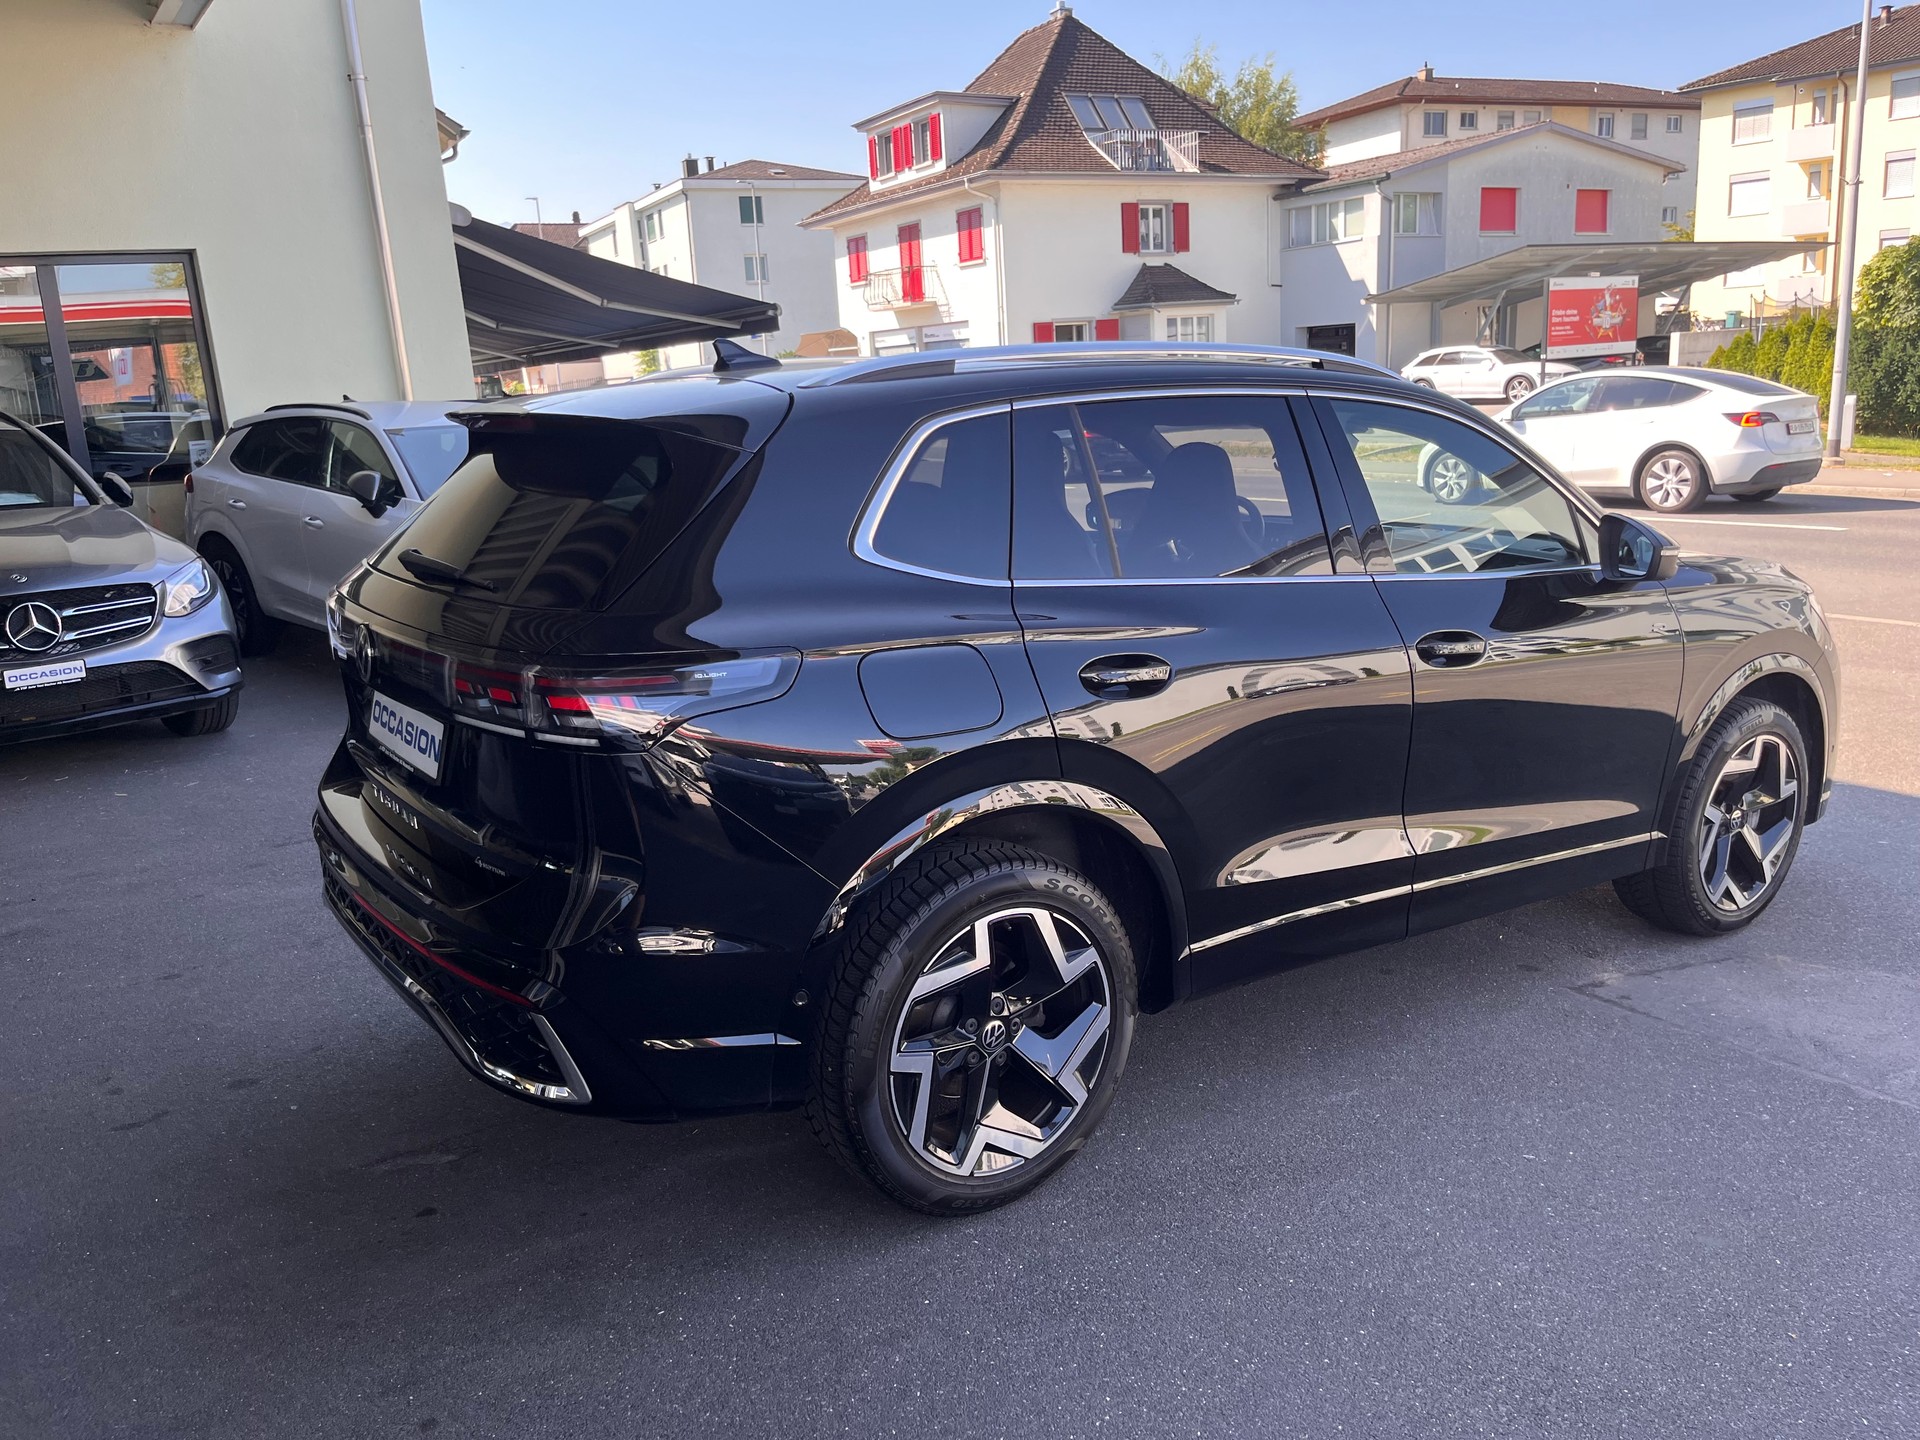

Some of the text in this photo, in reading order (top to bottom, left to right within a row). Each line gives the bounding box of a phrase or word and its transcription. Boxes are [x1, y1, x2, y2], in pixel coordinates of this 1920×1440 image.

[8, 665, 84, 683] OCCASION
[694, 671, 728, 679] IQ.LIGHT
[372, 699, 442, 764] OCCASION
[371, 783, 419, 830] TIGUAN
